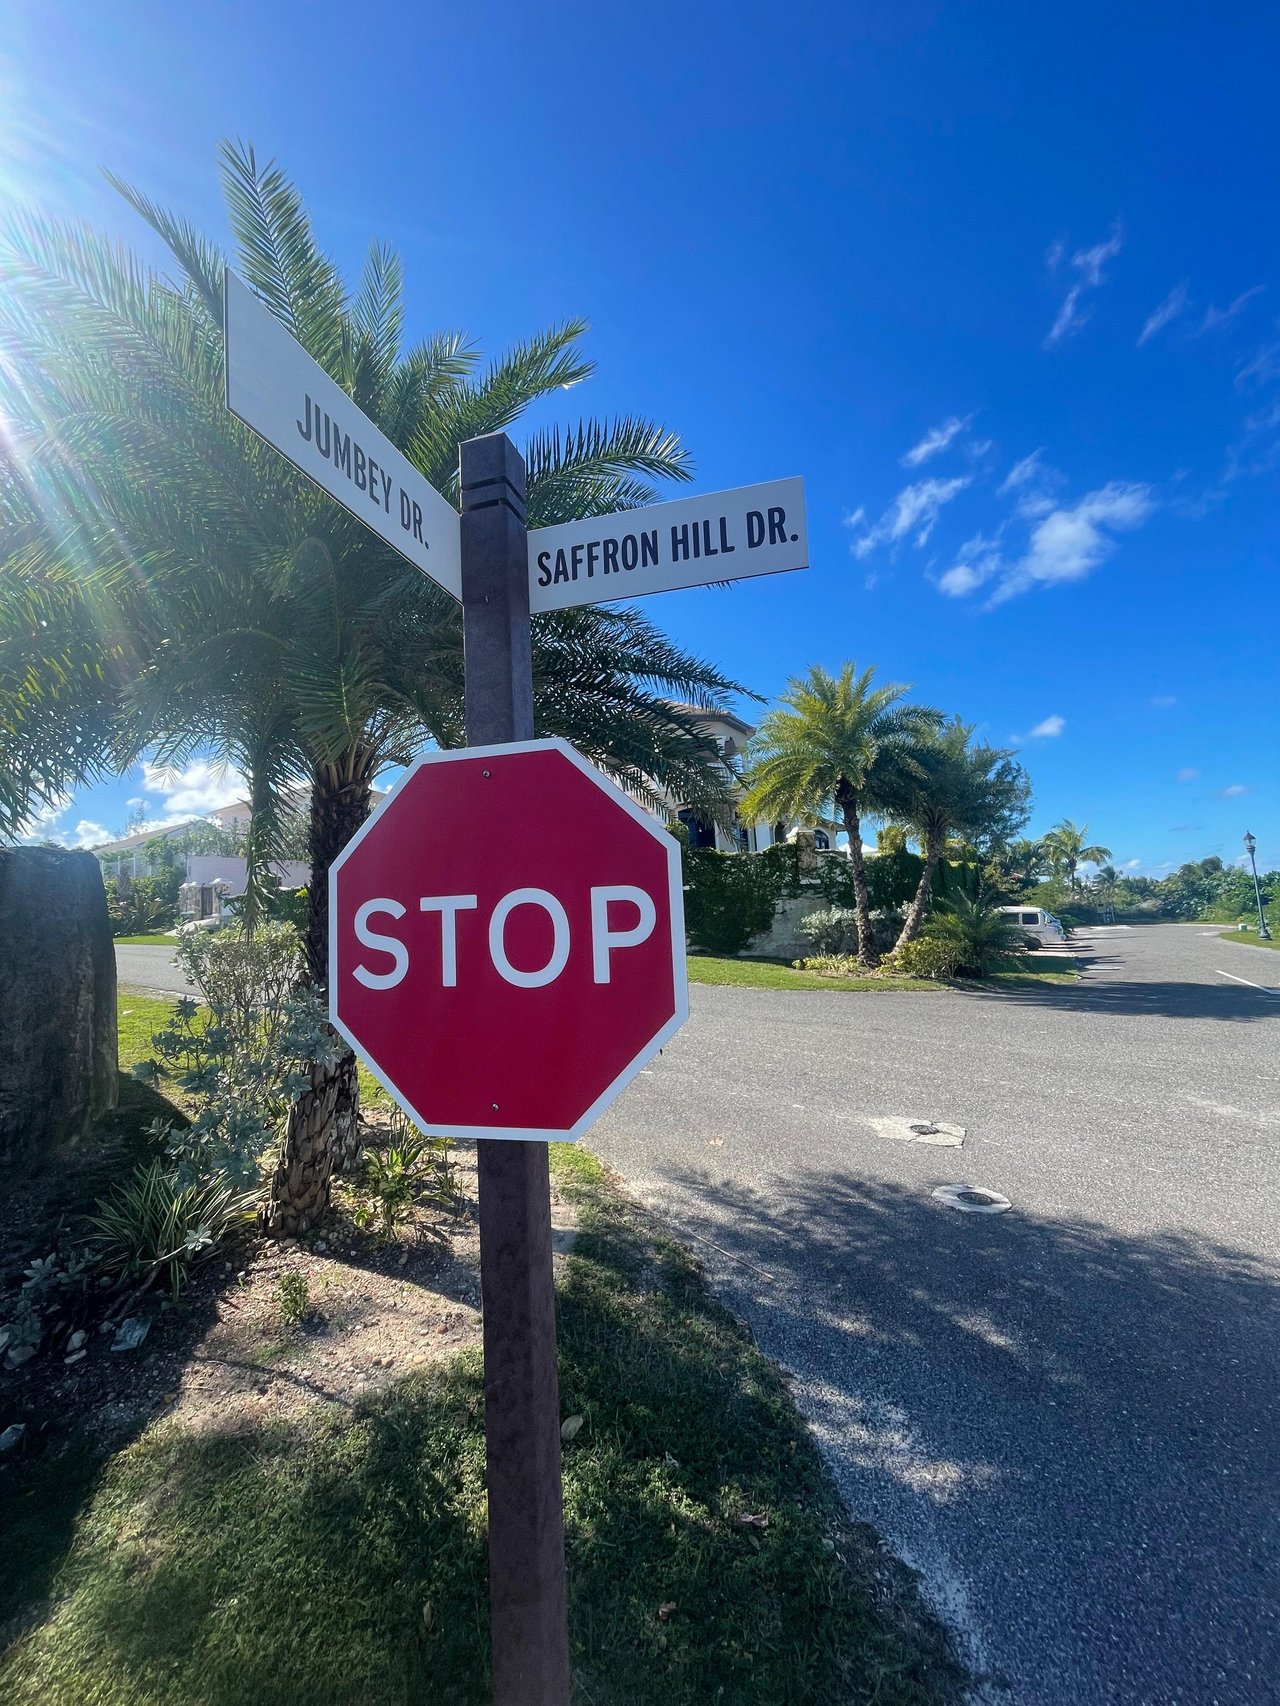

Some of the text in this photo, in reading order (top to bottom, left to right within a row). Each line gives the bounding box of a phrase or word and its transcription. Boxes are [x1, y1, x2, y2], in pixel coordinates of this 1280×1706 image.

[296, 394, 430, 550] JUMBEY DR.
[537, 506, 800, 588] SAFFRON HILL DR.
[352, 885, 657, 990] STOP
